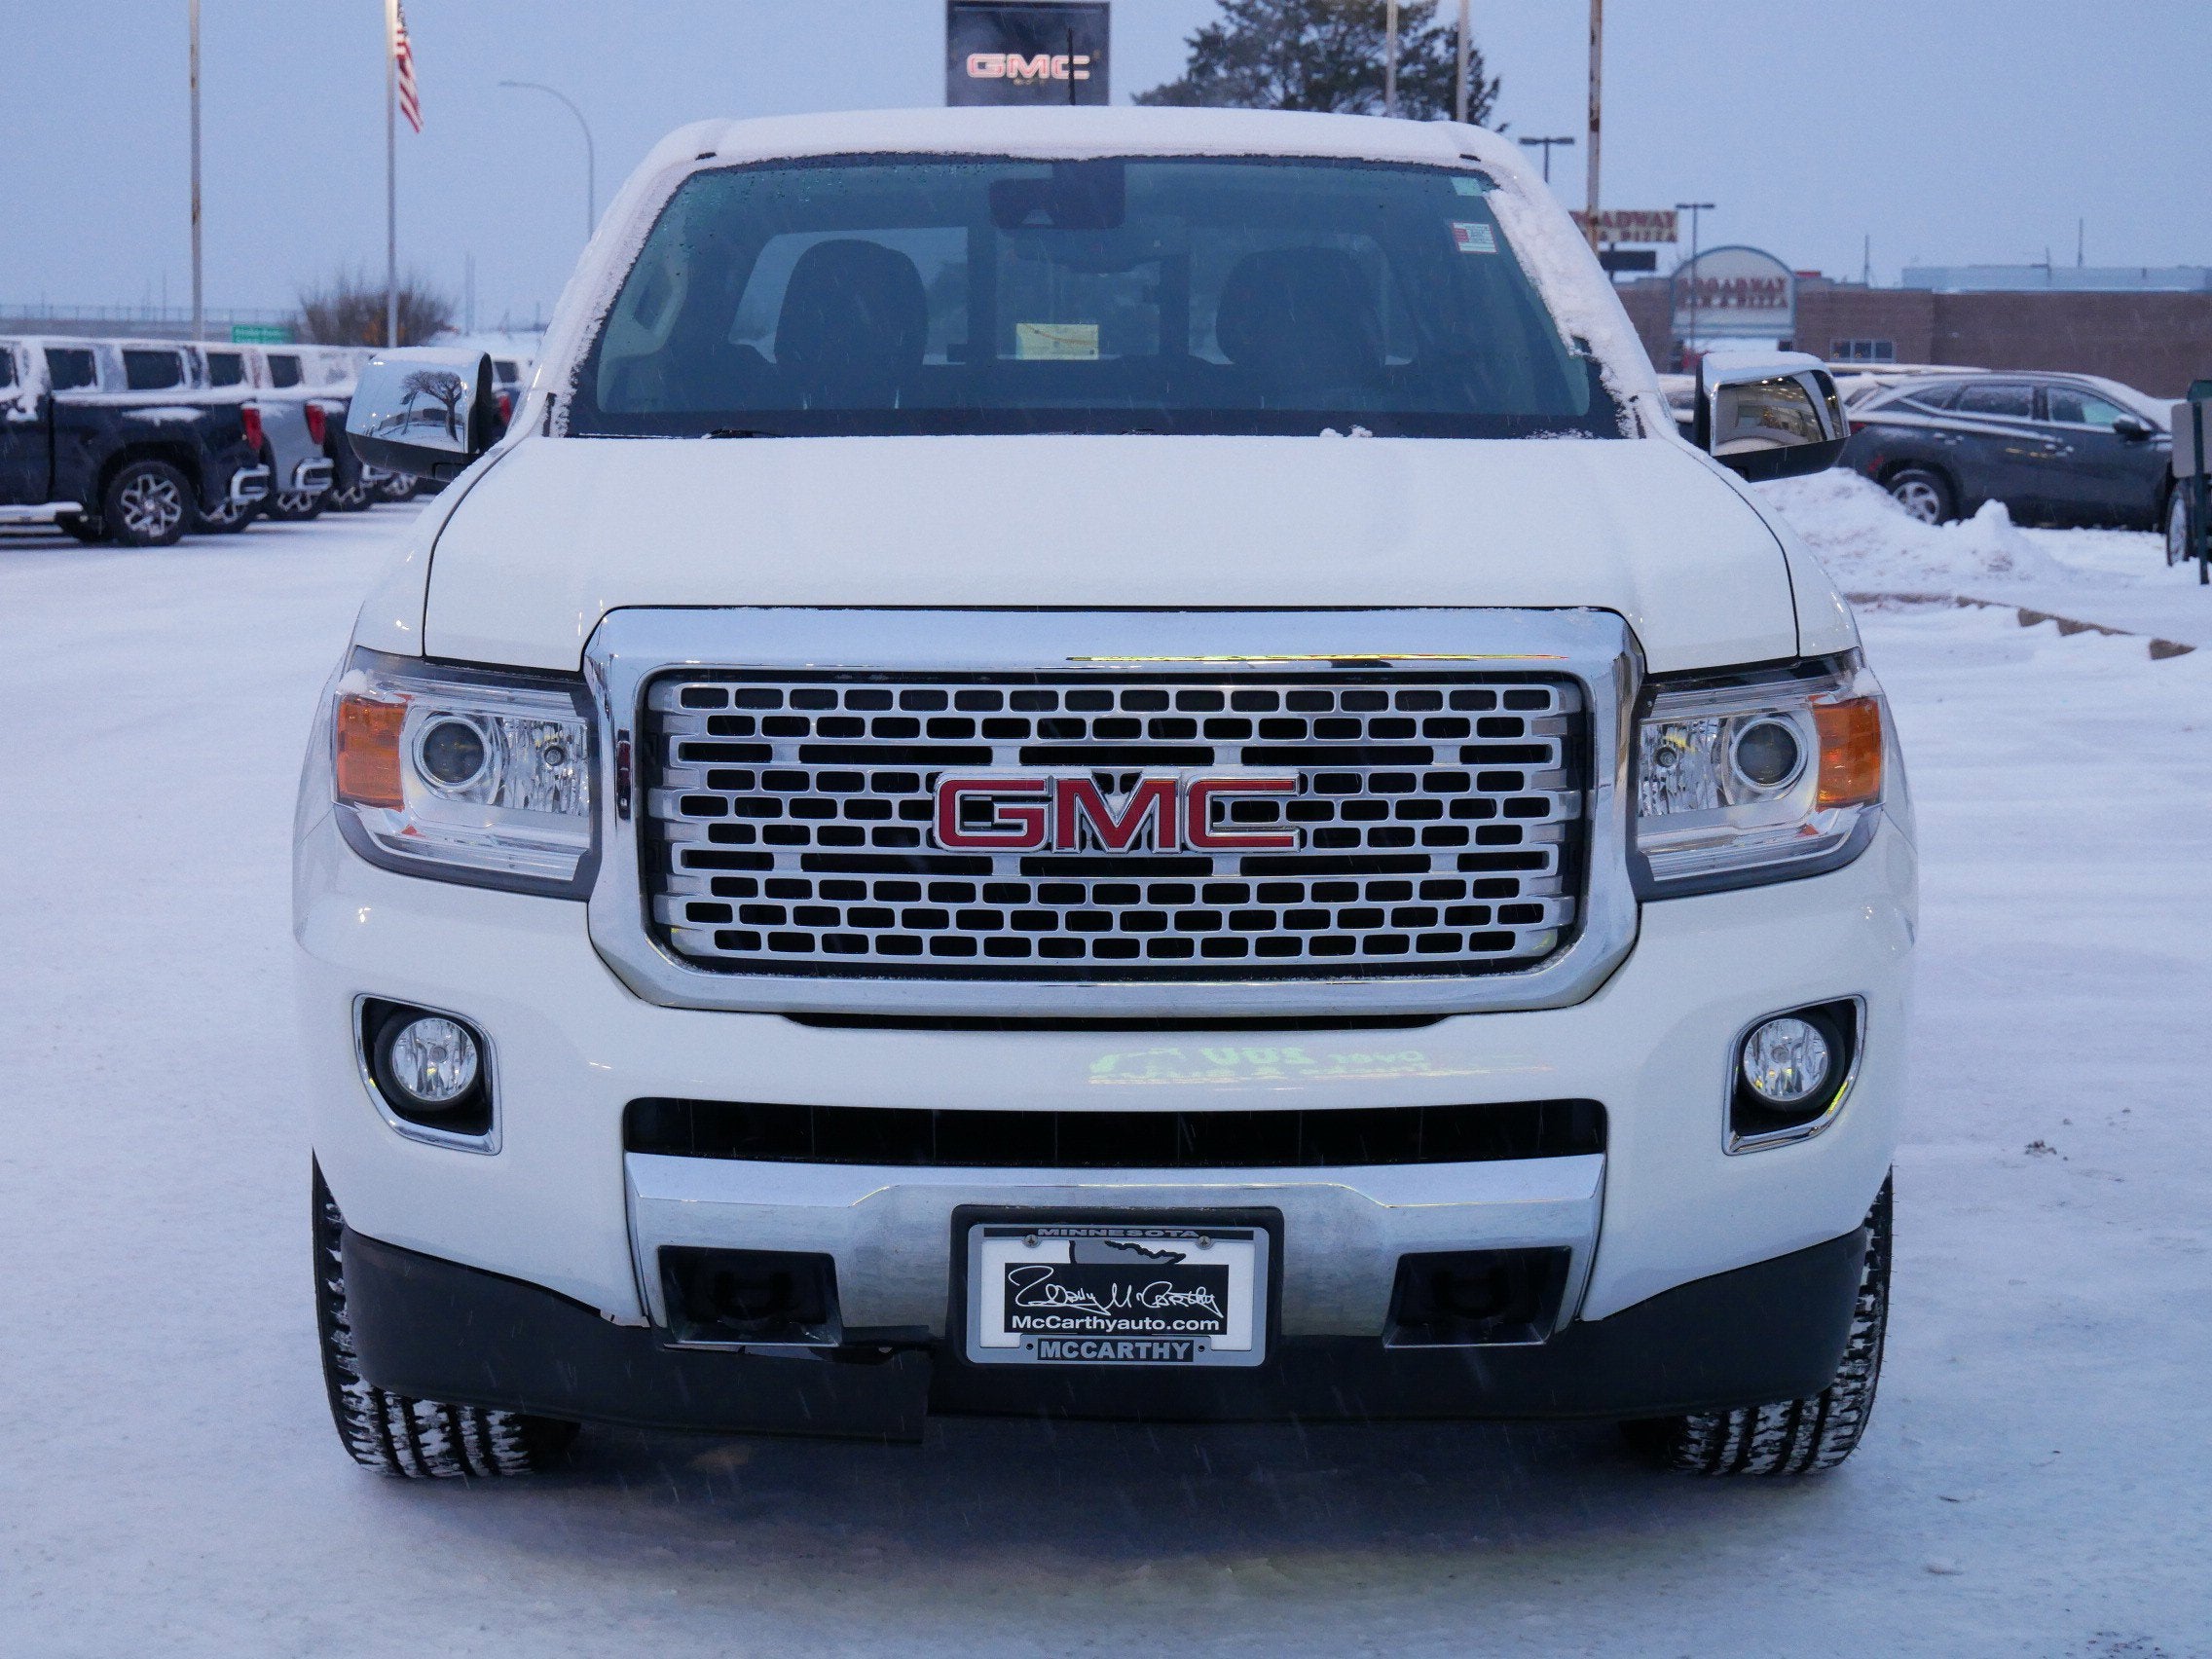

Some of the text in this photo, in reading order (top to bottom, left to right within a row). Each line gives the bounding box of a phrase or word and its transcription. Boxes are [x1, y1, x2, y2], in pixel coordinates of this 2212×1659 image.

[967, 54, 1090, 80] GMC
[934, 771, 1300, 854] GMC
[1038, 1228, 1199, 1237] MINNESOTA
[1012, 1315, 1219, 1333] McCarthyauto.com
[1040, 1341, 1191, 1359] MCCARTHY
